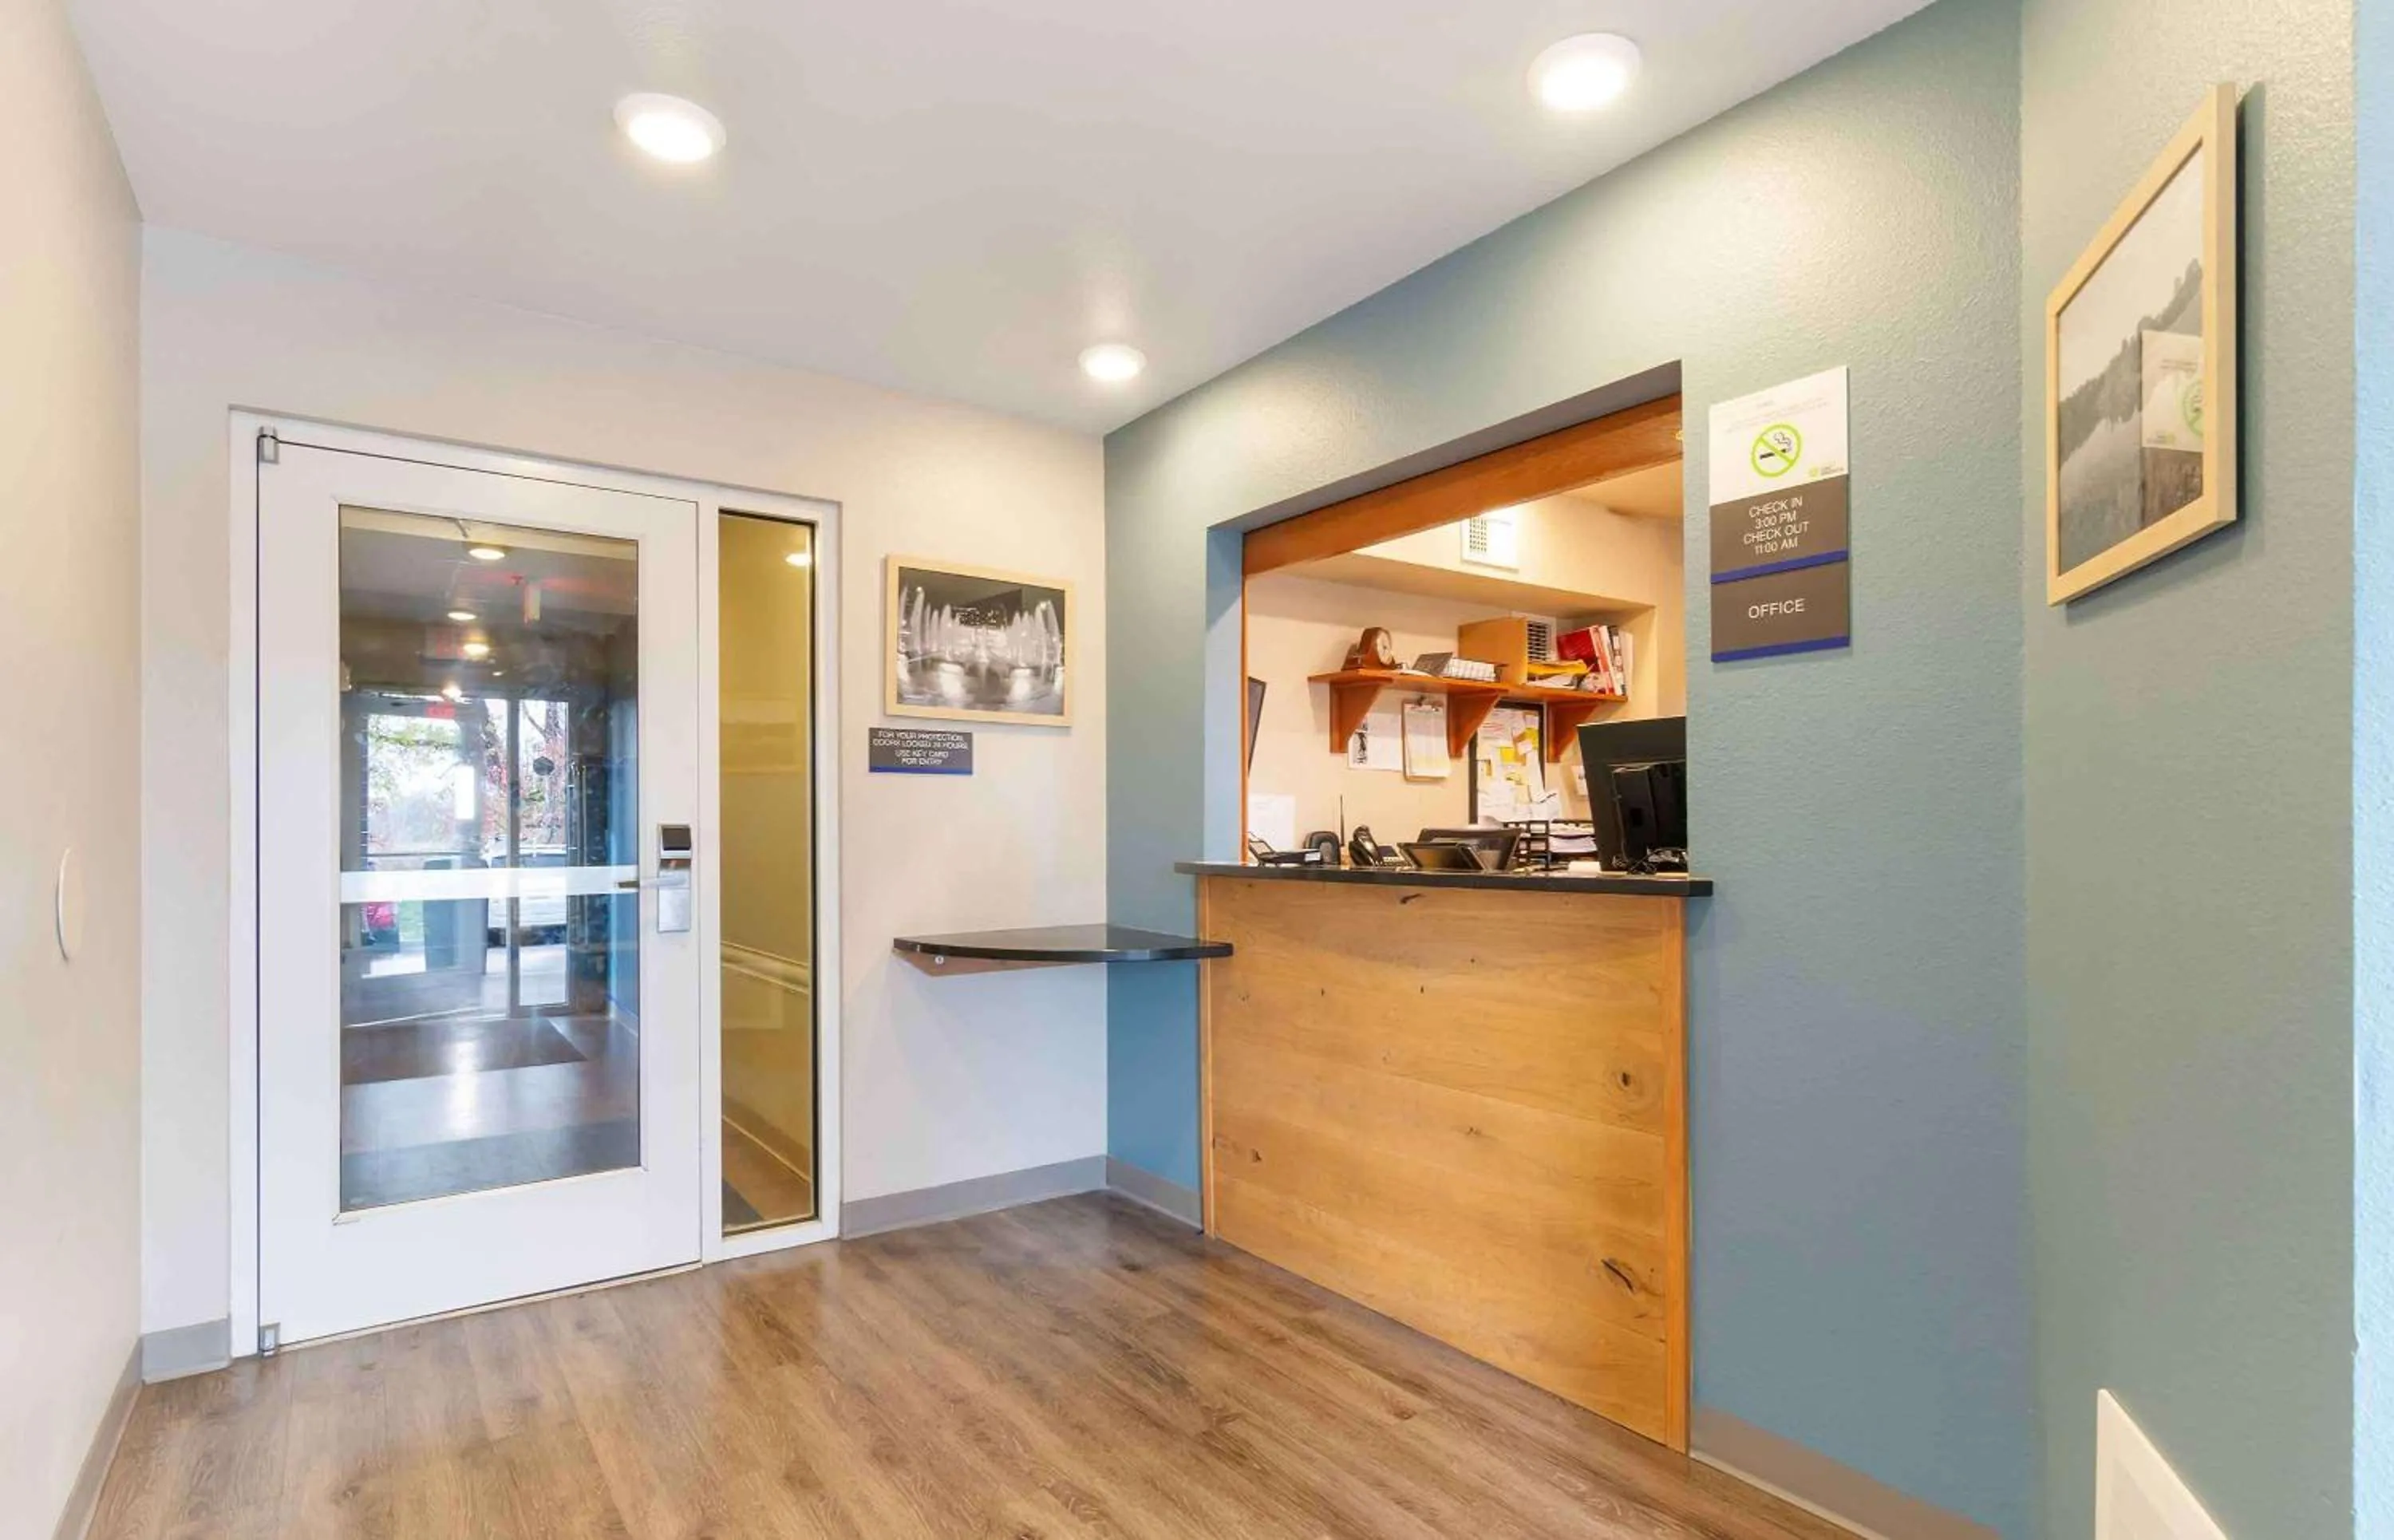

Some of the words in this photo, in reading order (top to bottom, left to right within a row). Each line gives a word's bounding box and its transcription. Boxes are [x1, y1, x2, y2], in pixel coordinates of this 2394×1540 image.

[1748, 499, 1788, 518] CHECK
[1791, 496, 1803, 508] IN
[1755, 515, 1777, 530] 3:00
[1779, 510, 1796, 524] PM
[1744, 527, 1782, 545] CHECK
[1784, 521, 1810, 536] OUT
[1755, 541, 1779, 555] 11:00
[1780, 536, 1798, 550] AM
[1748, 598, 1806, 618] OFFICE
[878, 730, 895, 739] FOR
[895, 749, 911, 758] USE
[912, 749, 926, 758] KEY
[928, 750, 949, 759] CARD
[901, 757, 917, 766] FOR
